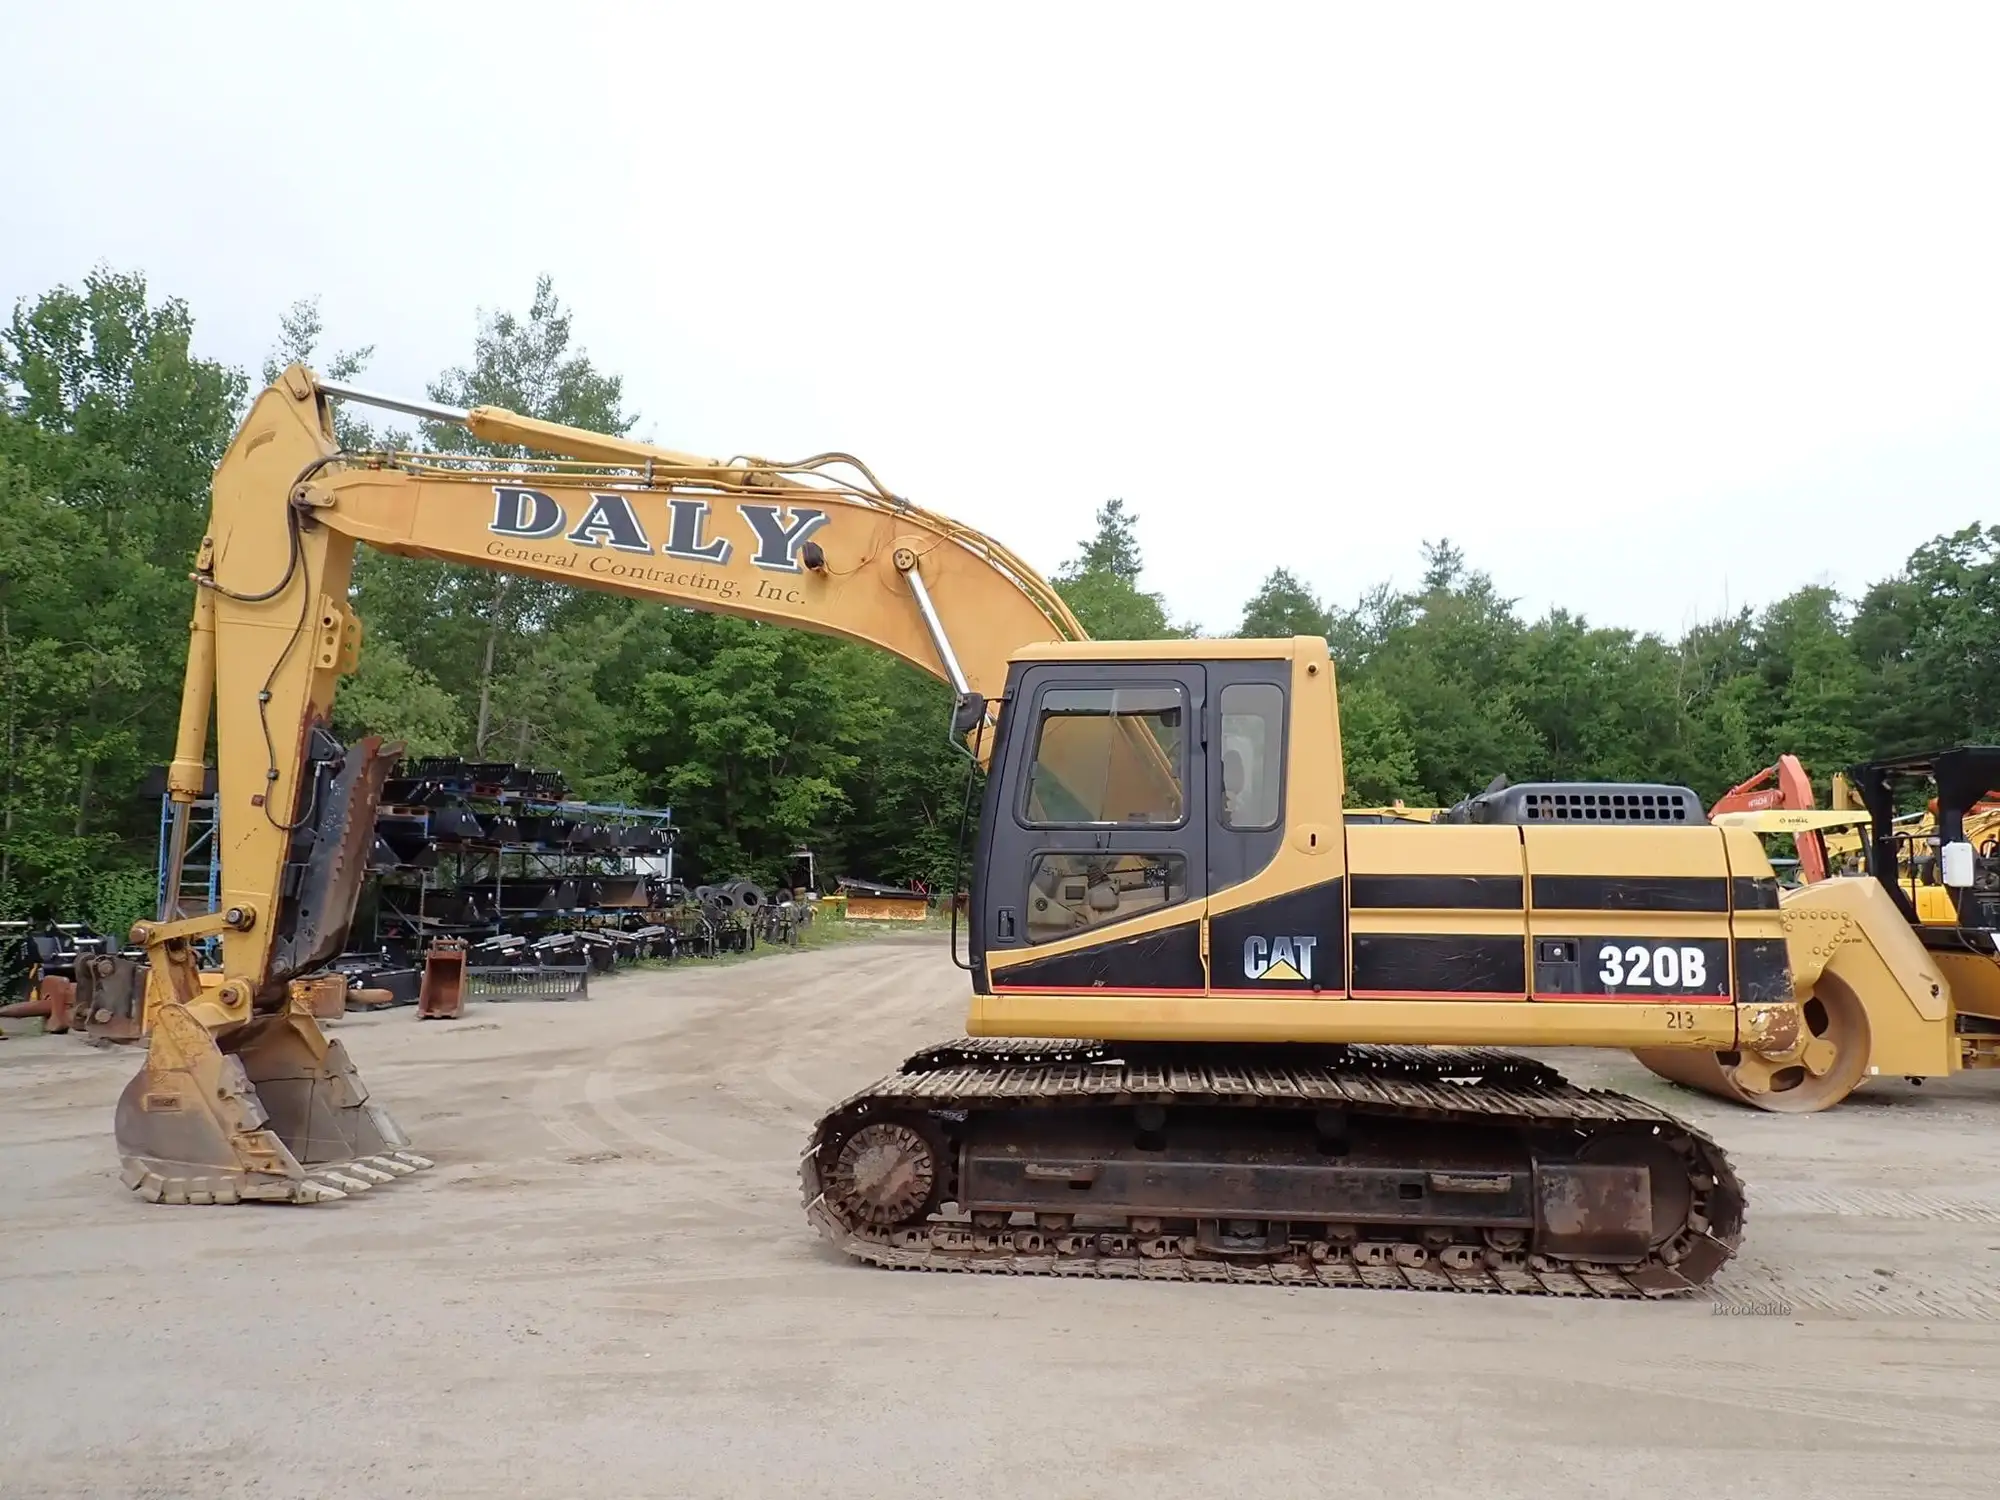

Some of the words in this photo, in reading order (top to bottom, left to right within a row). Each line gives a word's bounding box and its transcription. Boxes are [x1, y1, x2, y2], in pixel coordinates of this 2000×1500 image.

[487, 485, 832, 576] DALY
[486, 540, 579, 569] General
[588, 555, 742, 598] Contracting,
[754, 579, 806, 605] Inc.
[1243, 935, 1317, 980] CAT
[1598, 945, 1707, 989] 320B
[1665, 1010, 1695, 1029] 213
